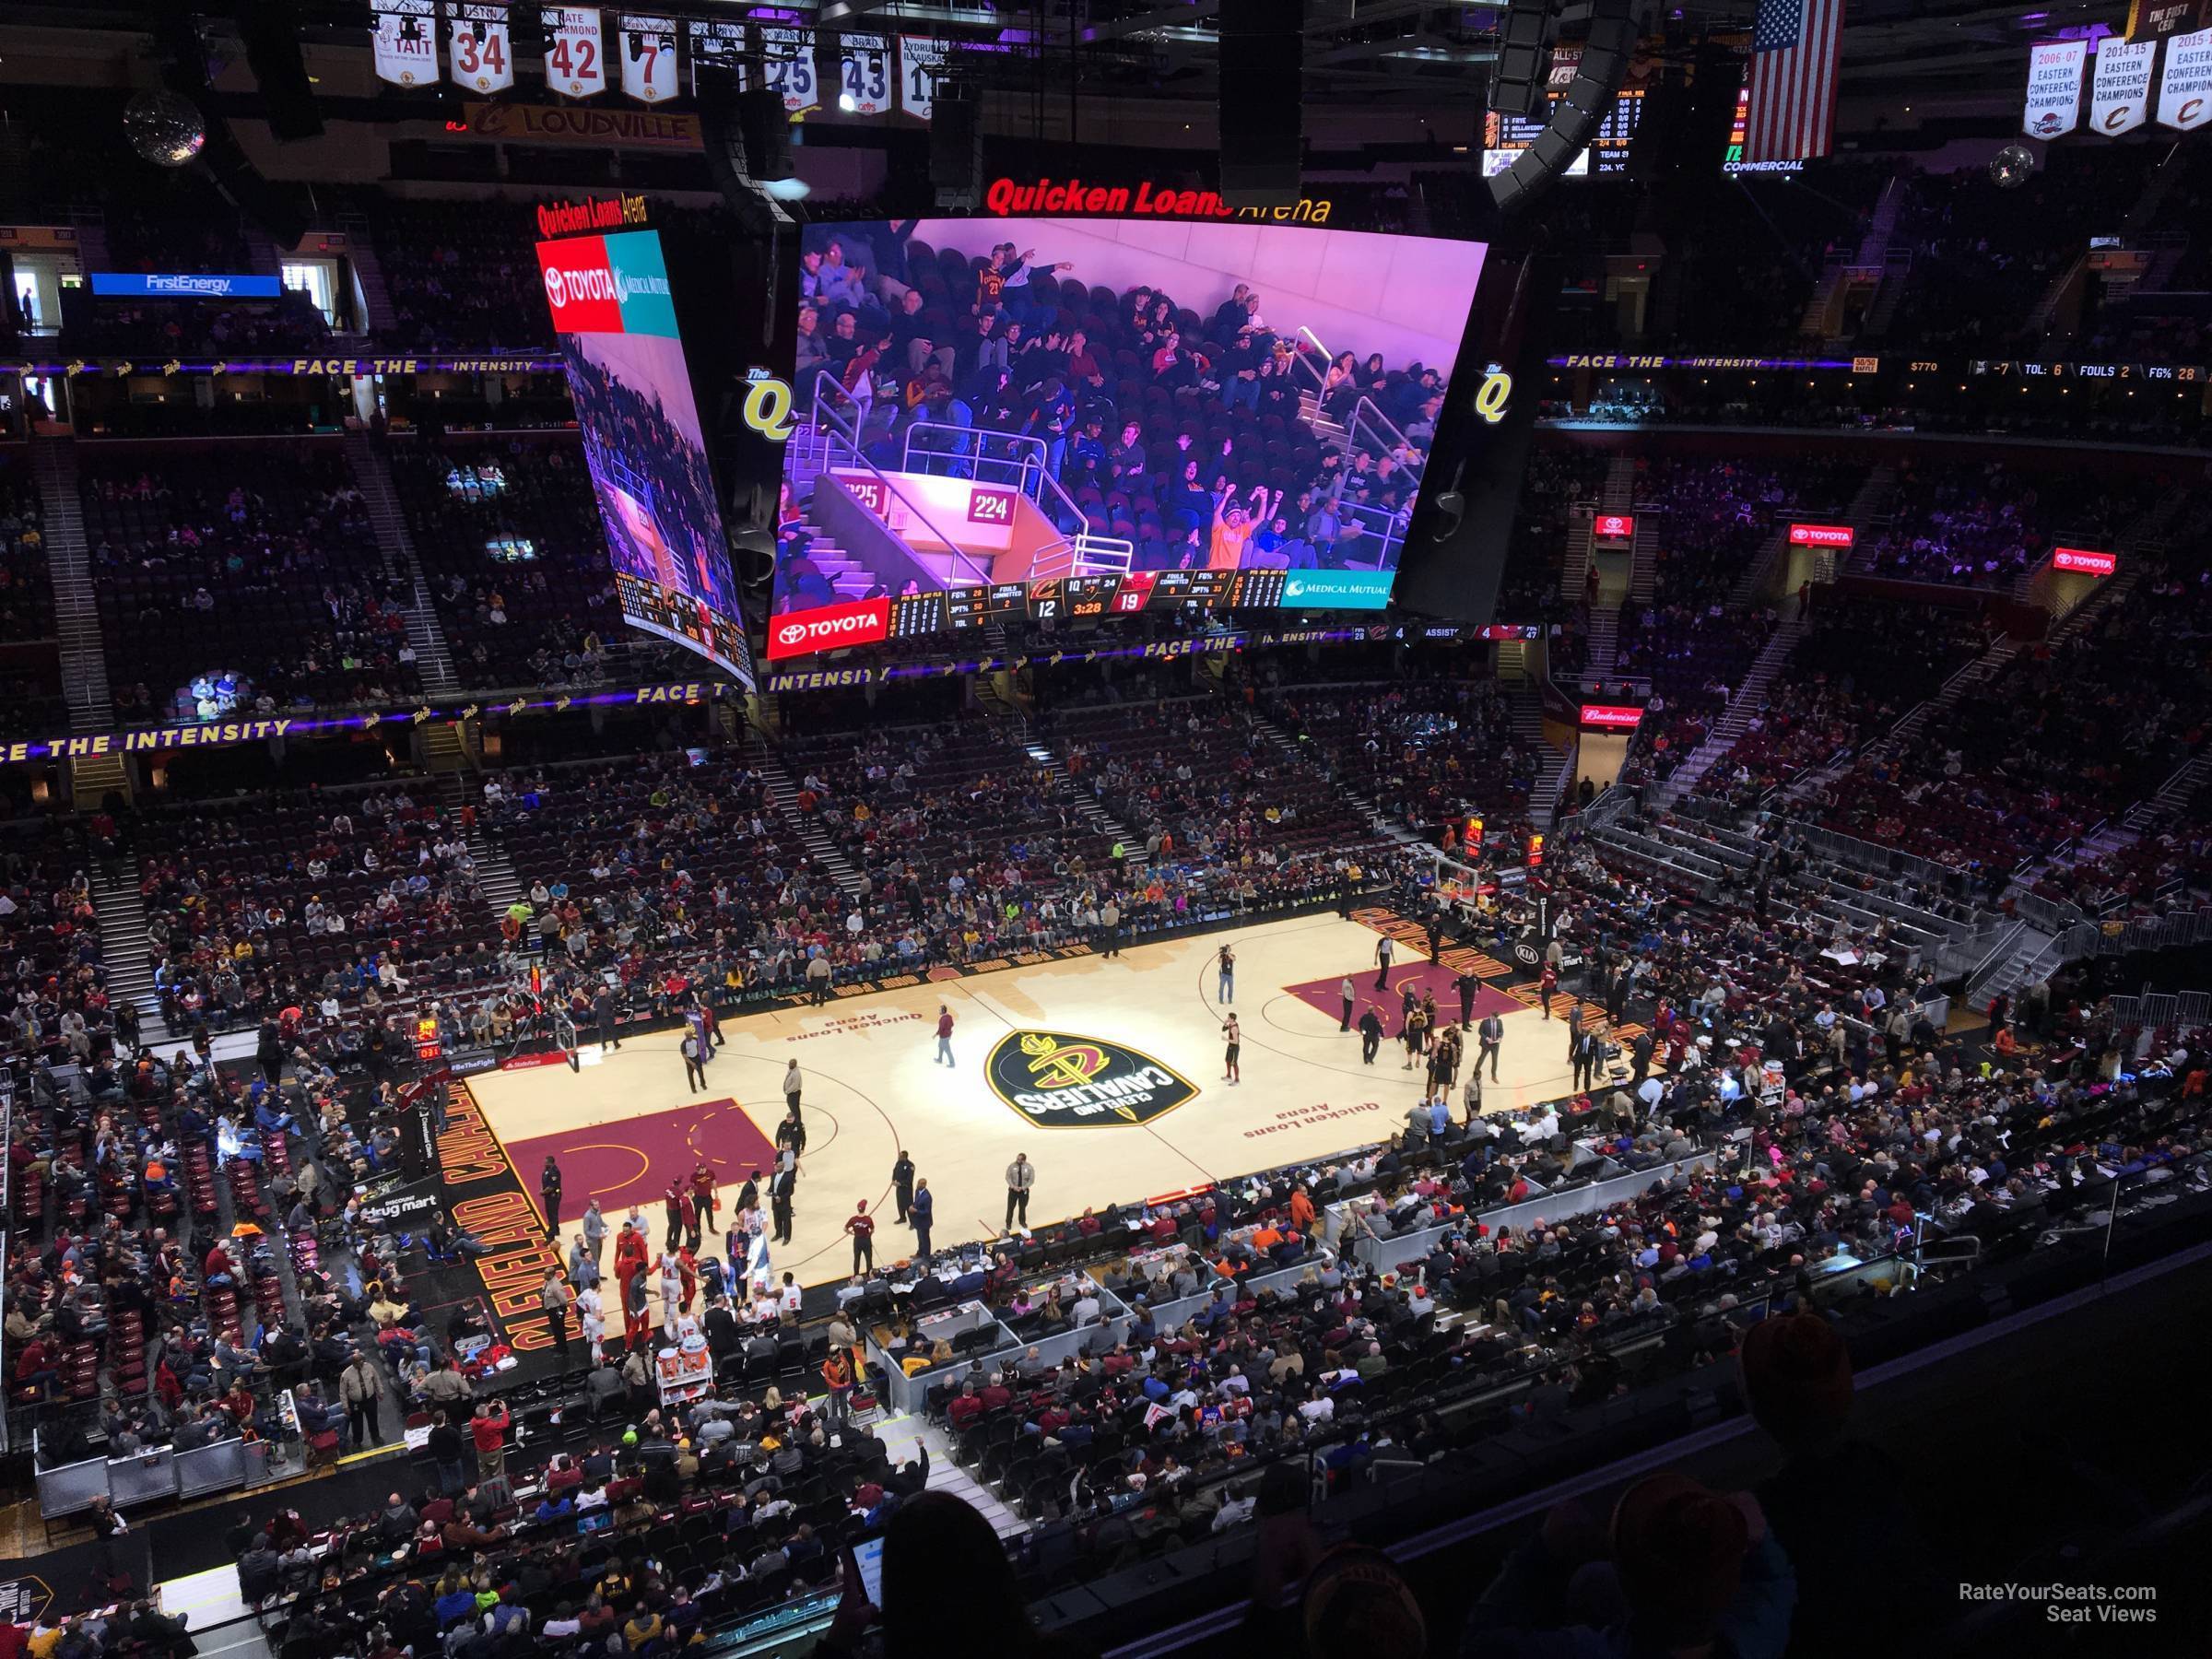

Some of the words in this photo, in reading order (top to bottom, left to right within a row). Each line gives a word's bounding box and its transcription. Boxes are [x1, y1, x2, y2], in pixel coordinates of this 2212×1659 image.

[394, 38, 432, 55] TAIT
[2178, 33, 2212, 48] 2015-1
[458, 33, 505, 75] 34
[2105, 43, 2147, 58] 2014-15
[552, 39, 597, 78] 42
[642, 46, 657, 83] 7
[2039, 51, 2077, 65] 2006-07
[2177, 51, 2212, 65] EASTER
[2038, 67, 2073, 81] EASTERN
[2105, 60, 2142, 74] EASTERN
[2167, 65, 2212, 79] CONFEREN
[847, 61, 886, 100] 43
[2030, 79, 2077, 95] CONFERENCE
[2096, 73, 2147, 88] CONFERENCE
[2167, 79, 2212, 94] CHAMPION
[2030, 95, 2074, 108] CHAMPIONS
[2096, 88, 2143, 101] CHAMPIONS
[523, 108, 689, 139] LOUDVILLE
[1723, 161, 1804, 172] COMMERCIAL
[987, 178, 1129, 216] Quicken
[537, 200, 590, 239] Quicken
[588, 195, 623, 228] Loans
[621, 192, 647, 225] Arena
[147, 276, 229, 292] FirstEnergy
[562, 268, 617, 301] TOYOTA
[293, 360, 356, 374] FACE
[374, 360, 418, 373] THE
[453, 361, 534, 371] INTENSITY
[1486, 364, 1502, 373] The
[1567, 356, 1617, 368] FACE
[1629, 356, 1665, 368] THE
[1692, 359, 1762, 368] INTENSITY
[1911, 362, 1939, 371] $770
[1994, 362, 2009, 375] -7
[747, 369, 771, 380] The
[2026, 364, 2048, 375] TOL:
[2053, 364, 2063, 376] 6
[2080, 366, 2116, 377] FOULS
[2121, 366, 2130, 378] 2
[2148, 367, 2172, 379] FG%
[2178, 369, 2195, 380] 28
[1475, 373, 1512, 423] Q
[743, 380, 794, 440] Q
[975, 503, 1007, 528] 224
[1809, 532, 1849, 542] TOYOTA
[2072, 556, 2112, 569] TOYOTA
[1068, 580, 1080, 592] 1Q
[1104, 579, 1115, 587] 24
[1085, 585, 1095, 594] -7
[1306, 584, 1347, 594] MEDICAL
[1349, 585, 1388, 594] MUTUAL
[951, 591, 966, 599] FG%
[992, 591, 1022, 599] COMMITTED
[1121, 594, 1138, 609] 19
[950, 606, 969, 614] 3PT%
[1039, 601, 1056, 618] 12
[1074, 603, 1102, 615] 3:28
[808, 613, 877, 638] TOYOTA
[955, 619, 967, 628] TOL
[1395, 627, 1404, 638] 4
[1482, 627, 1489, 638] 4
[1144, 641, 1191, 657] FACE
[1204, 638, 1237, 651] THE
[1263, 630, 1326, 644] INENSITY
[636, 683, 700, 704] FACE
[1583, 709, 1641, 723] Budweiser
[47, 736, 110, 758] THE
[125, 719, 292, 750] INTENSITY
[1519, 947, 1535, 961] KIA
[824, 1013, 877, 1029] Arena
[849, 1013, 924, 1033] Quicken
[786, 1026, 846, 1043] Loans
[451, 1059, 496, 1072] #BeTheFight
[1016, 1065, 1175, 1114] CAVALIERS
[1077, 1091, 1154, 1116] CLEVELAND
[1276, 1102, 1329, 1120] Arena
[1304, 1102, 1381, 1124] Quicken
[1243, 1121, 1301, 1138] Loans
[369, 1206, 401, 1218] drug
[402, 1194, 438, 1212] mart
[384, 1194, 415, 1206] DISCOUNT
[789, 1298, 796, 1309] 5
